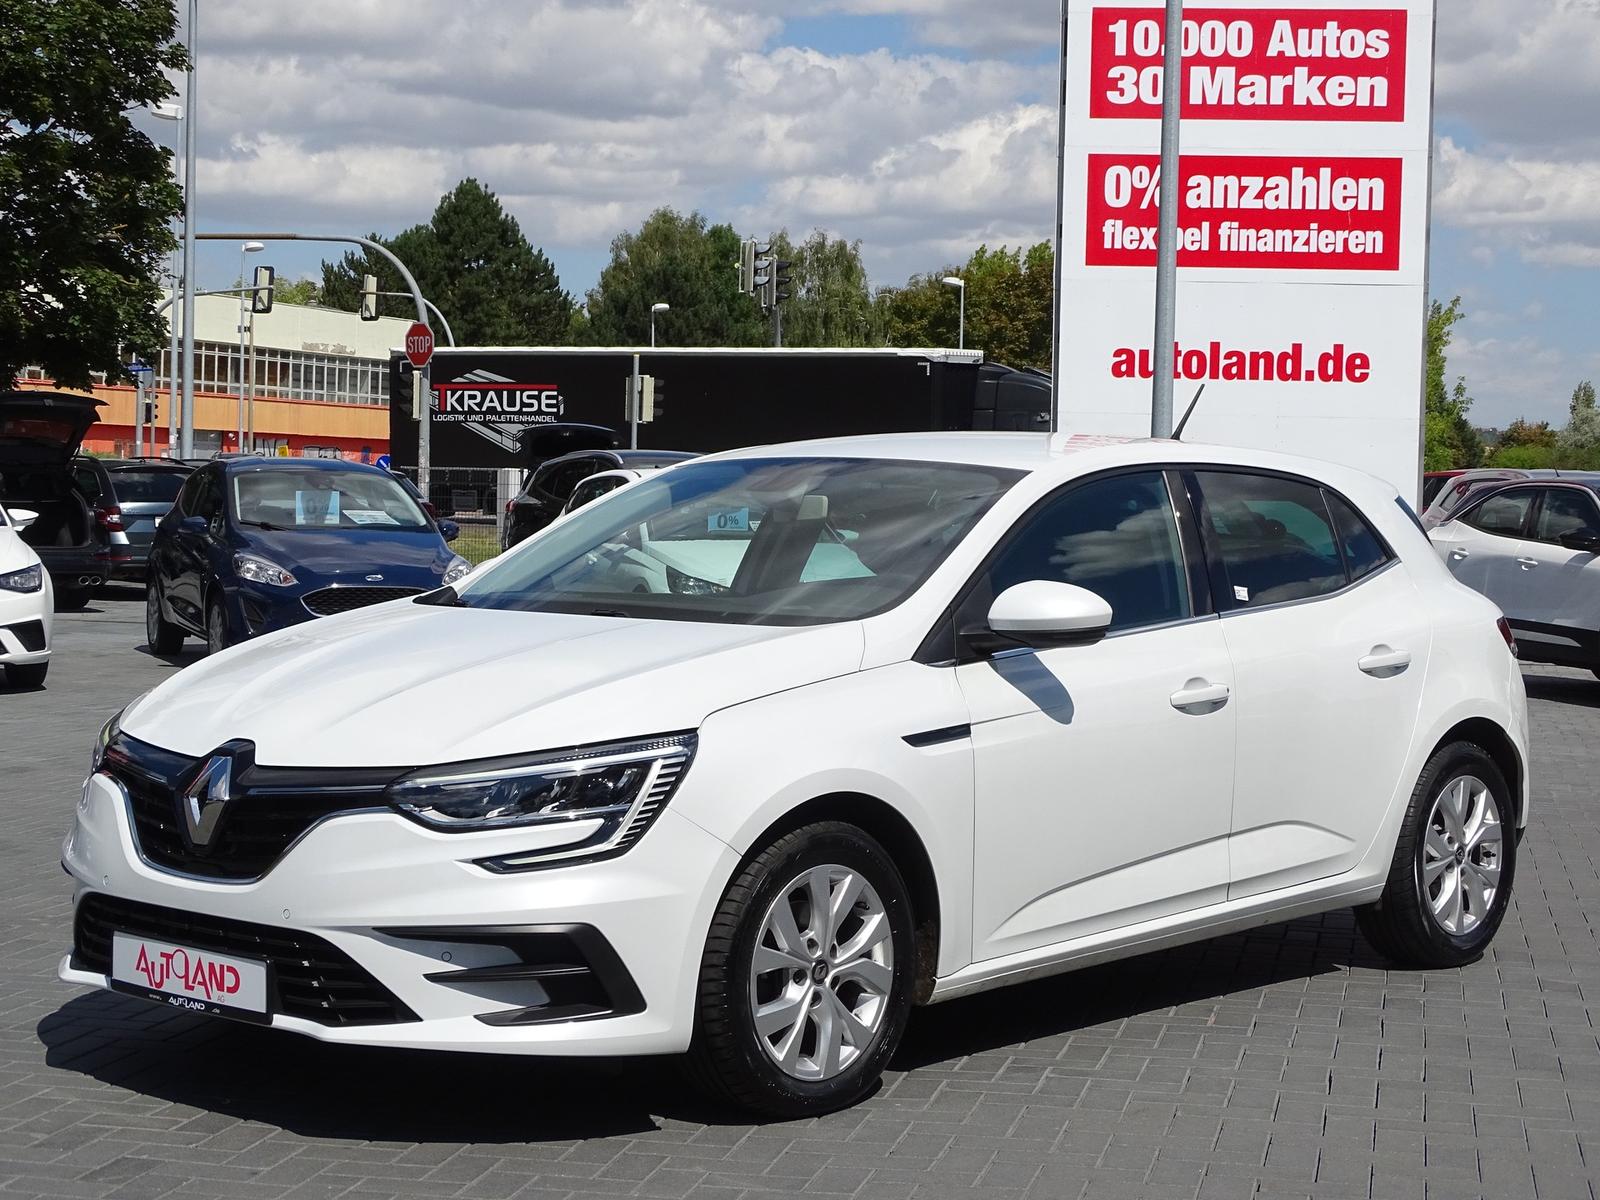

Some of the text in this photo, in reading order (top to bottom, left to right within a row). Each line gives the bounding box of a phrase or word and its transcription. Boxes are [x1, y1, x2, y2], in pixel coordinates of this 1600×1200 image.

[1108, 19, 1390, 59] 10000 Autos
[1106, 65, 1389, 107] 30 Marken
[1104, 165, 1385, 211] 0% anzahlen
[1102, 218, 1384, 254] flexel finanzieren
[408, 335, 431, 354] STOP
[1110, 341, 1372, 384] autoland.de
[432, 413, 558, 423] LOGISTIK UND PALETTENHANDEL
[135, 943, 241, 1000] AUTOLAND
[168, 995, 206, 1011] AUTOLAND
